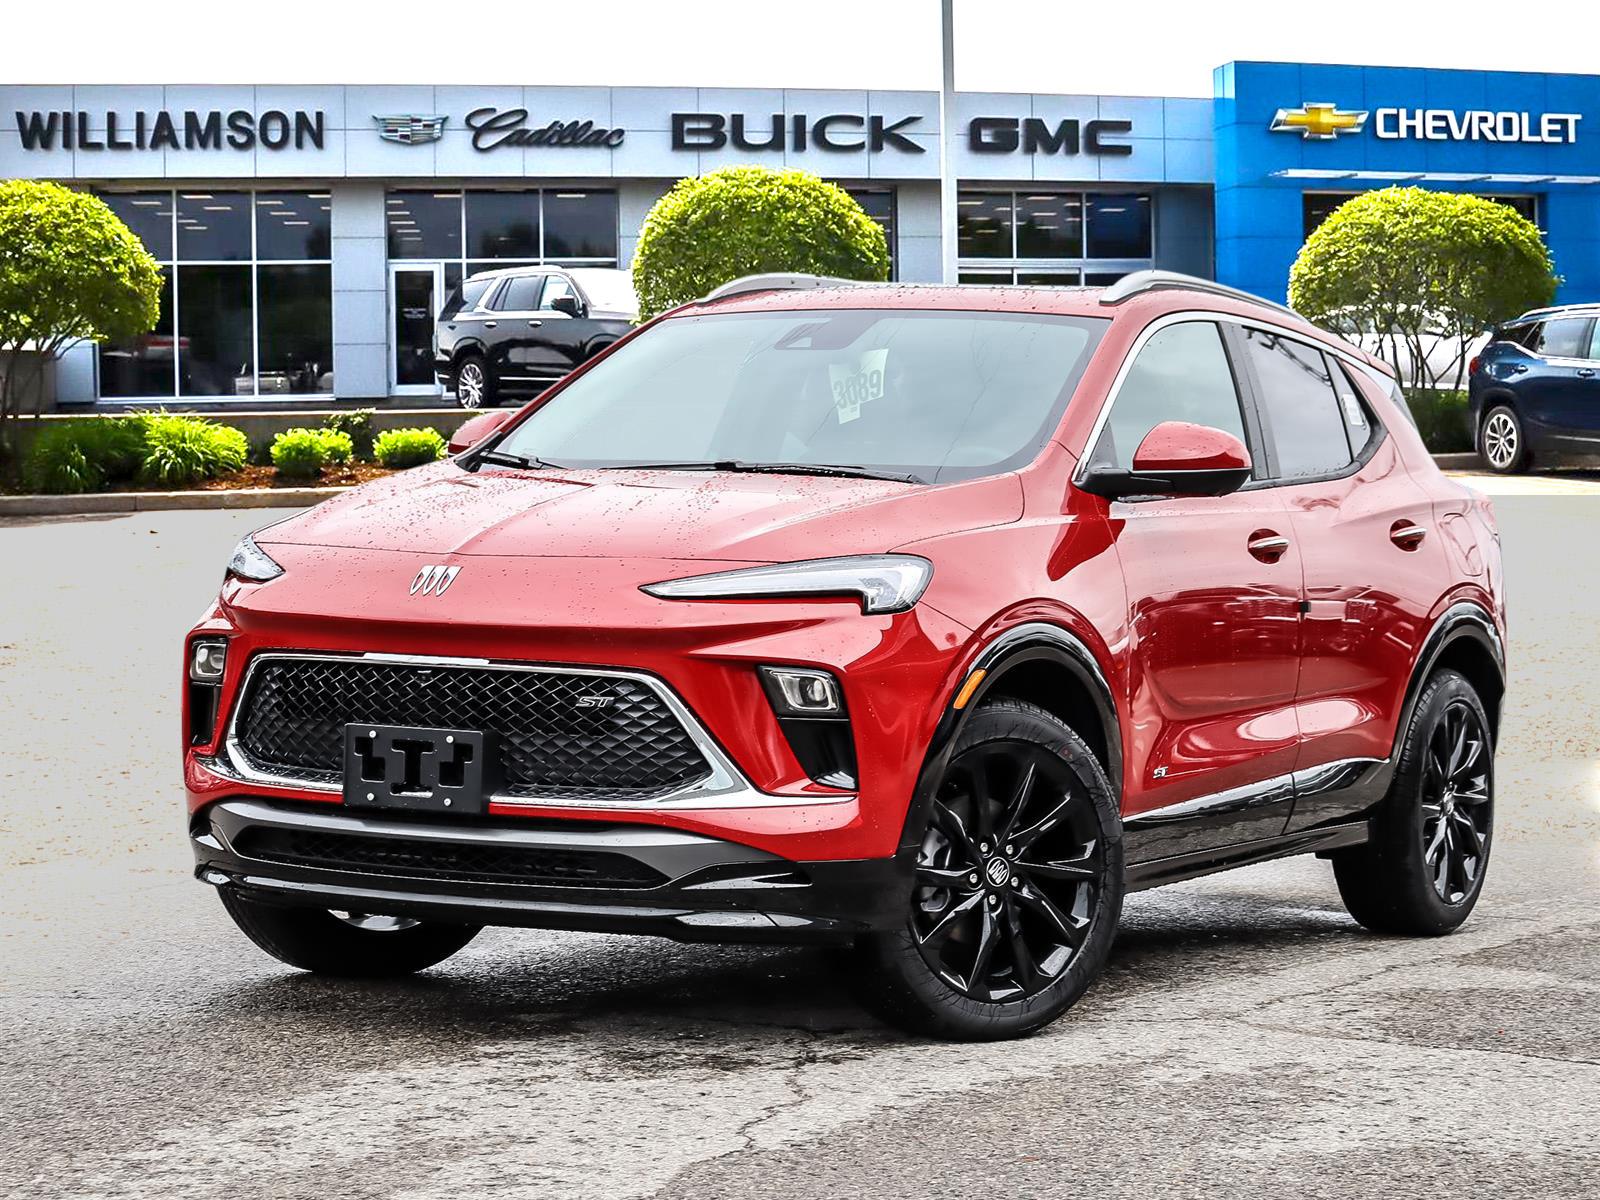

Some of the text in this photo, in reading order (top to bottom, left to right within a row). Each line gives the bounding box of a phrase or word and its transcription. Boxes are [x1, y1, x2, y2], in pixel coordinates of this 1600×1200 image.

[15, 110, 324, 151] WILLIAMSON
[465, 107, 625, 152] Cadillac
[671, 113, 926, 154] BUICK
[969, 117, 1132, 155] GMC
[1375, 107, 1582, 144] CHEVROLET
[833, 369, 882, 409] 3089
[576, 696, 615, 708] ST
